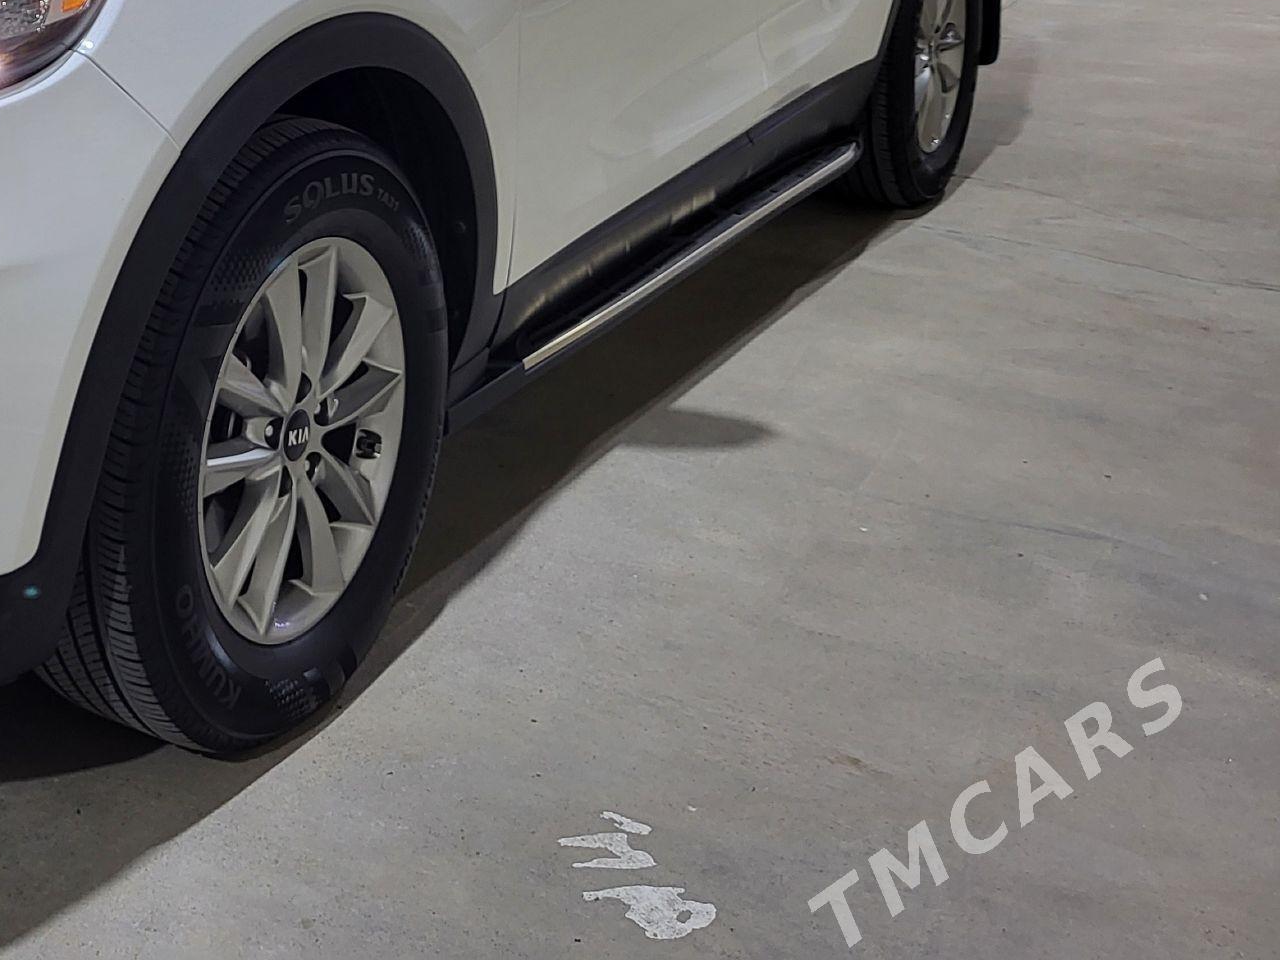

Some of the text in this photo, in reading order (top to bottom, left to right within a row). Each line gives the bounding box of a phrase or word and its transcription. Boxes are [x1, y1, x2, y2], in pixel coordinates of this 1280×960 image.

[283, 172, 375, 223] SOLUS
[288, 426, 309, 446] KIA
[176, 584, 242, 711] KUMHO
